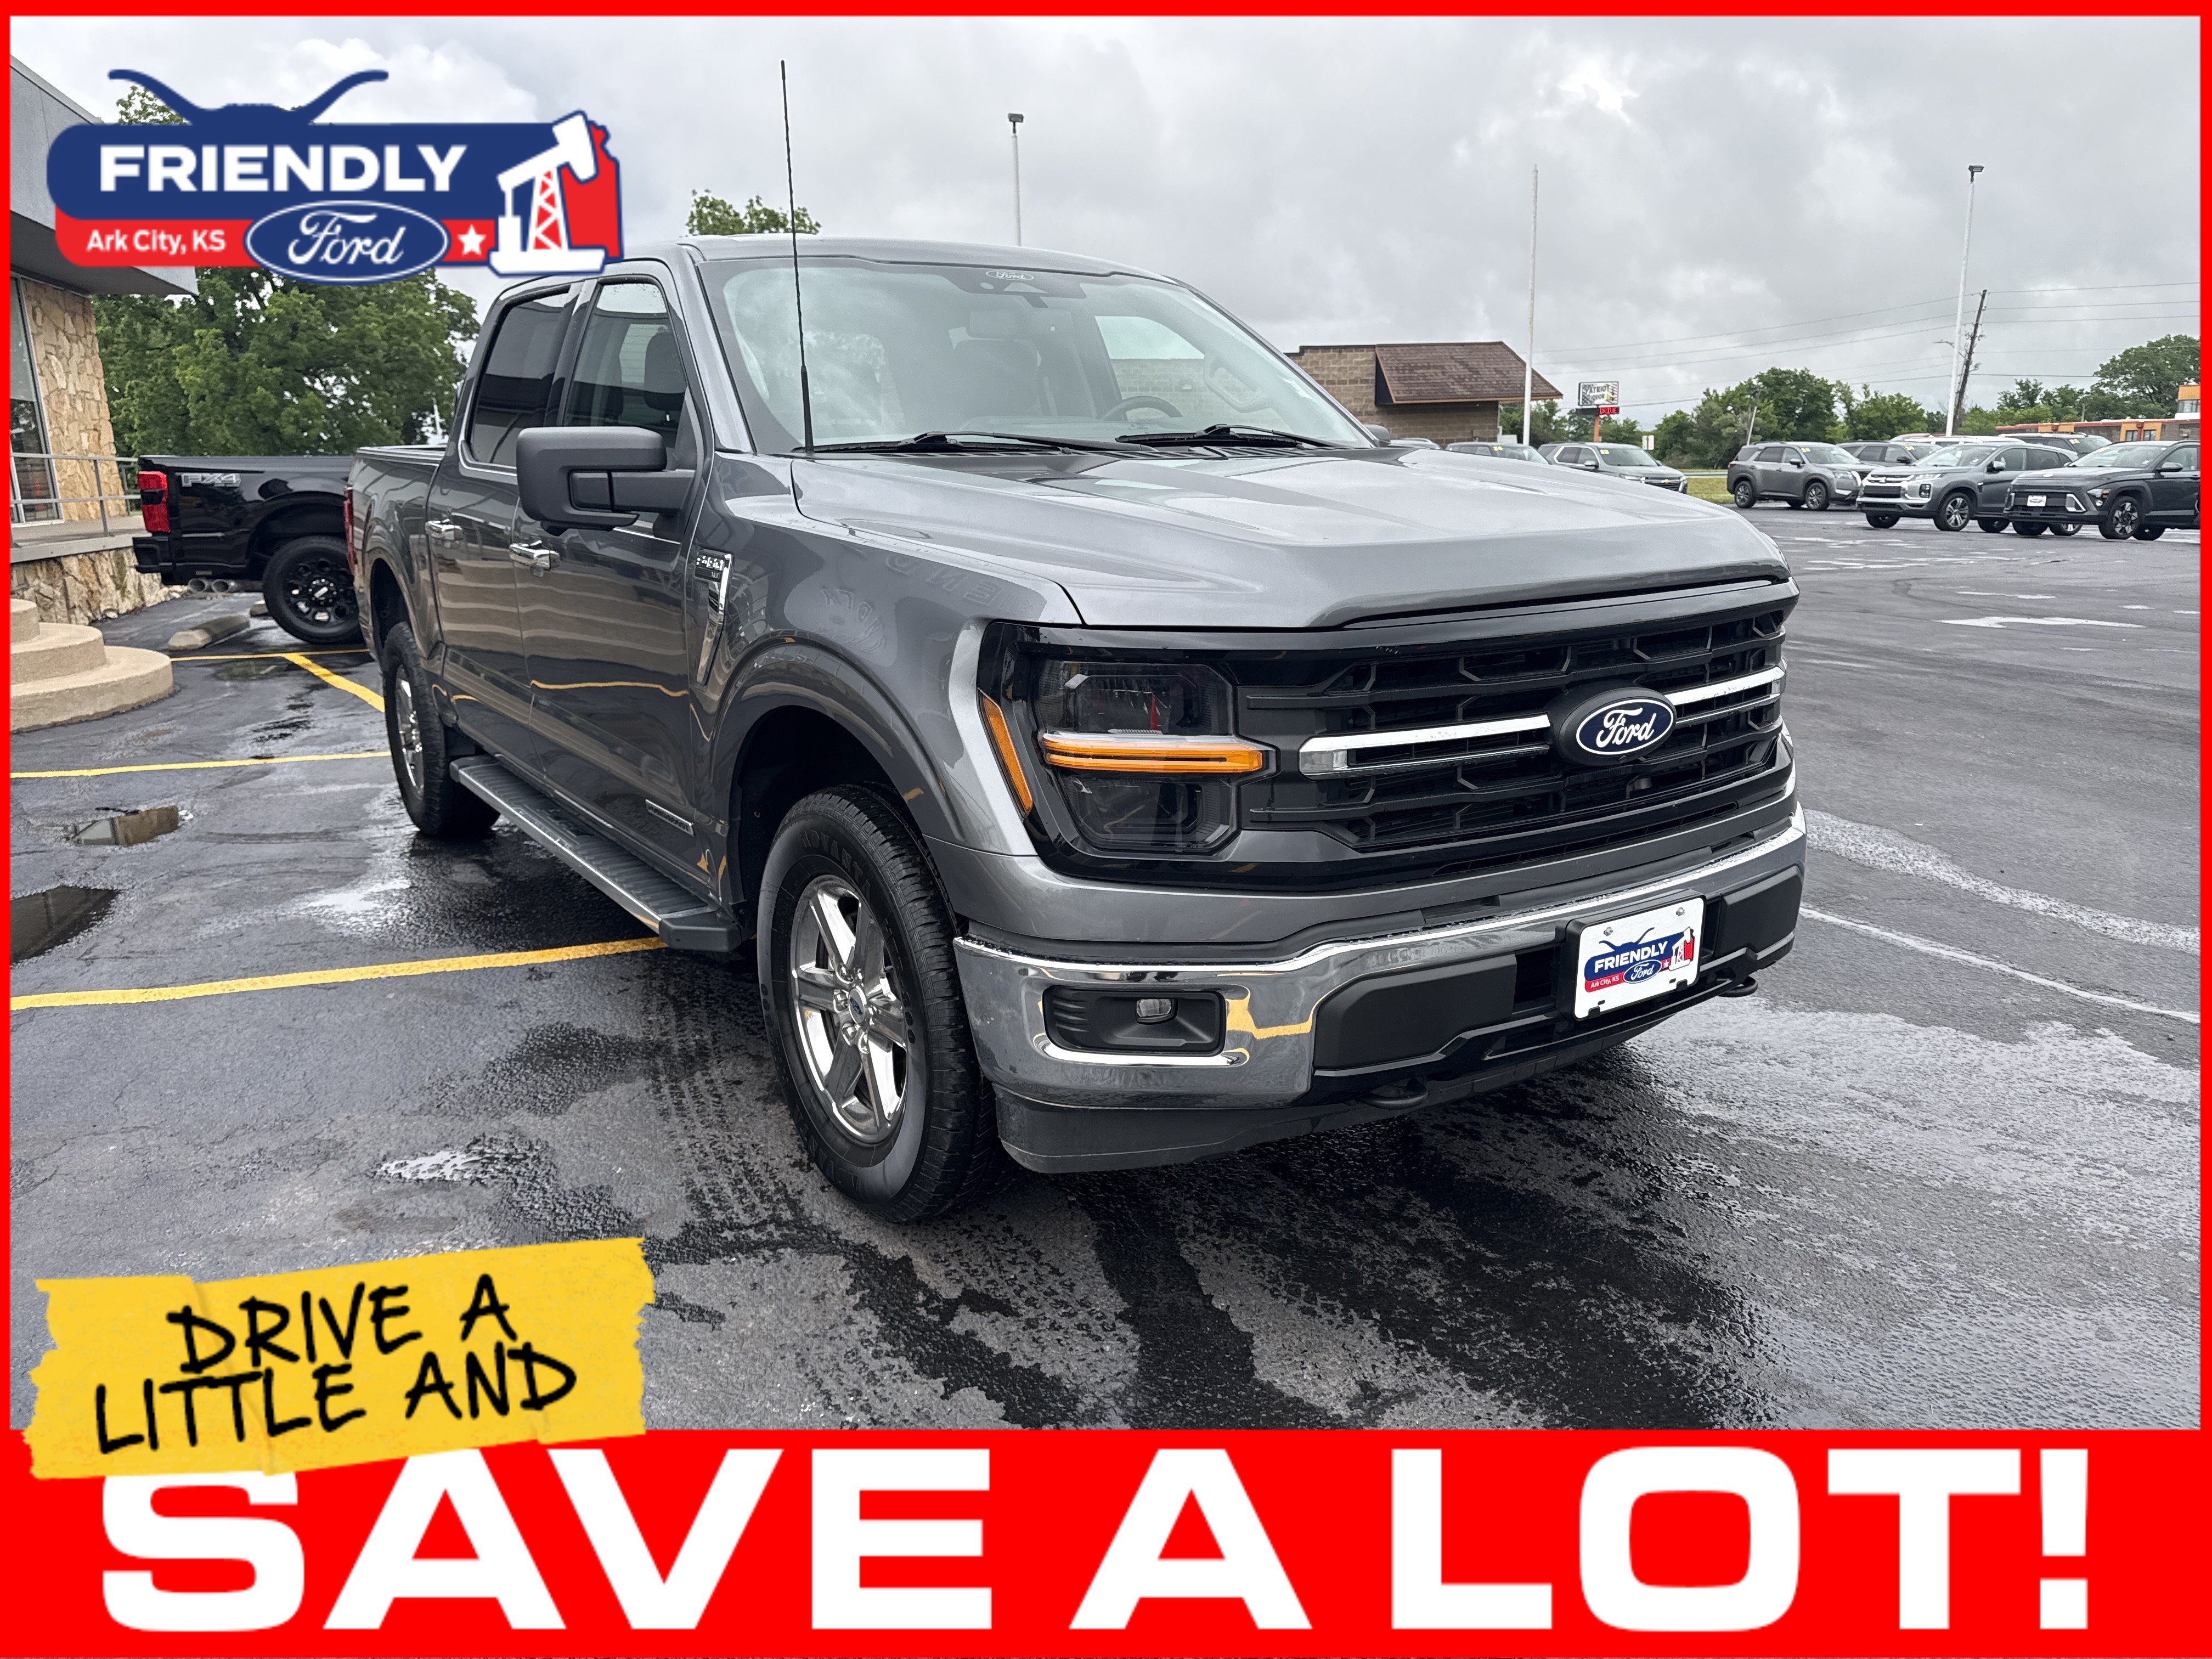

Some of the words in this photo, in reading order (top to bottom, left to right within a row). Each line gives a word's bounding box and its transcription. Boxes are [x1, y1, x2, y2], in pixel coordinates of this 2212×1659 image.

[996, 271, 1025, 279] Ford
[181, 473, 238, 487] FX4
[1595, 707, 1657, 748] Ford
[1594, 941, 1668, 973] FRIENDLY
[1630, 963, 1655, 981] Ford
[1600, 978, 1612, 986] City,
